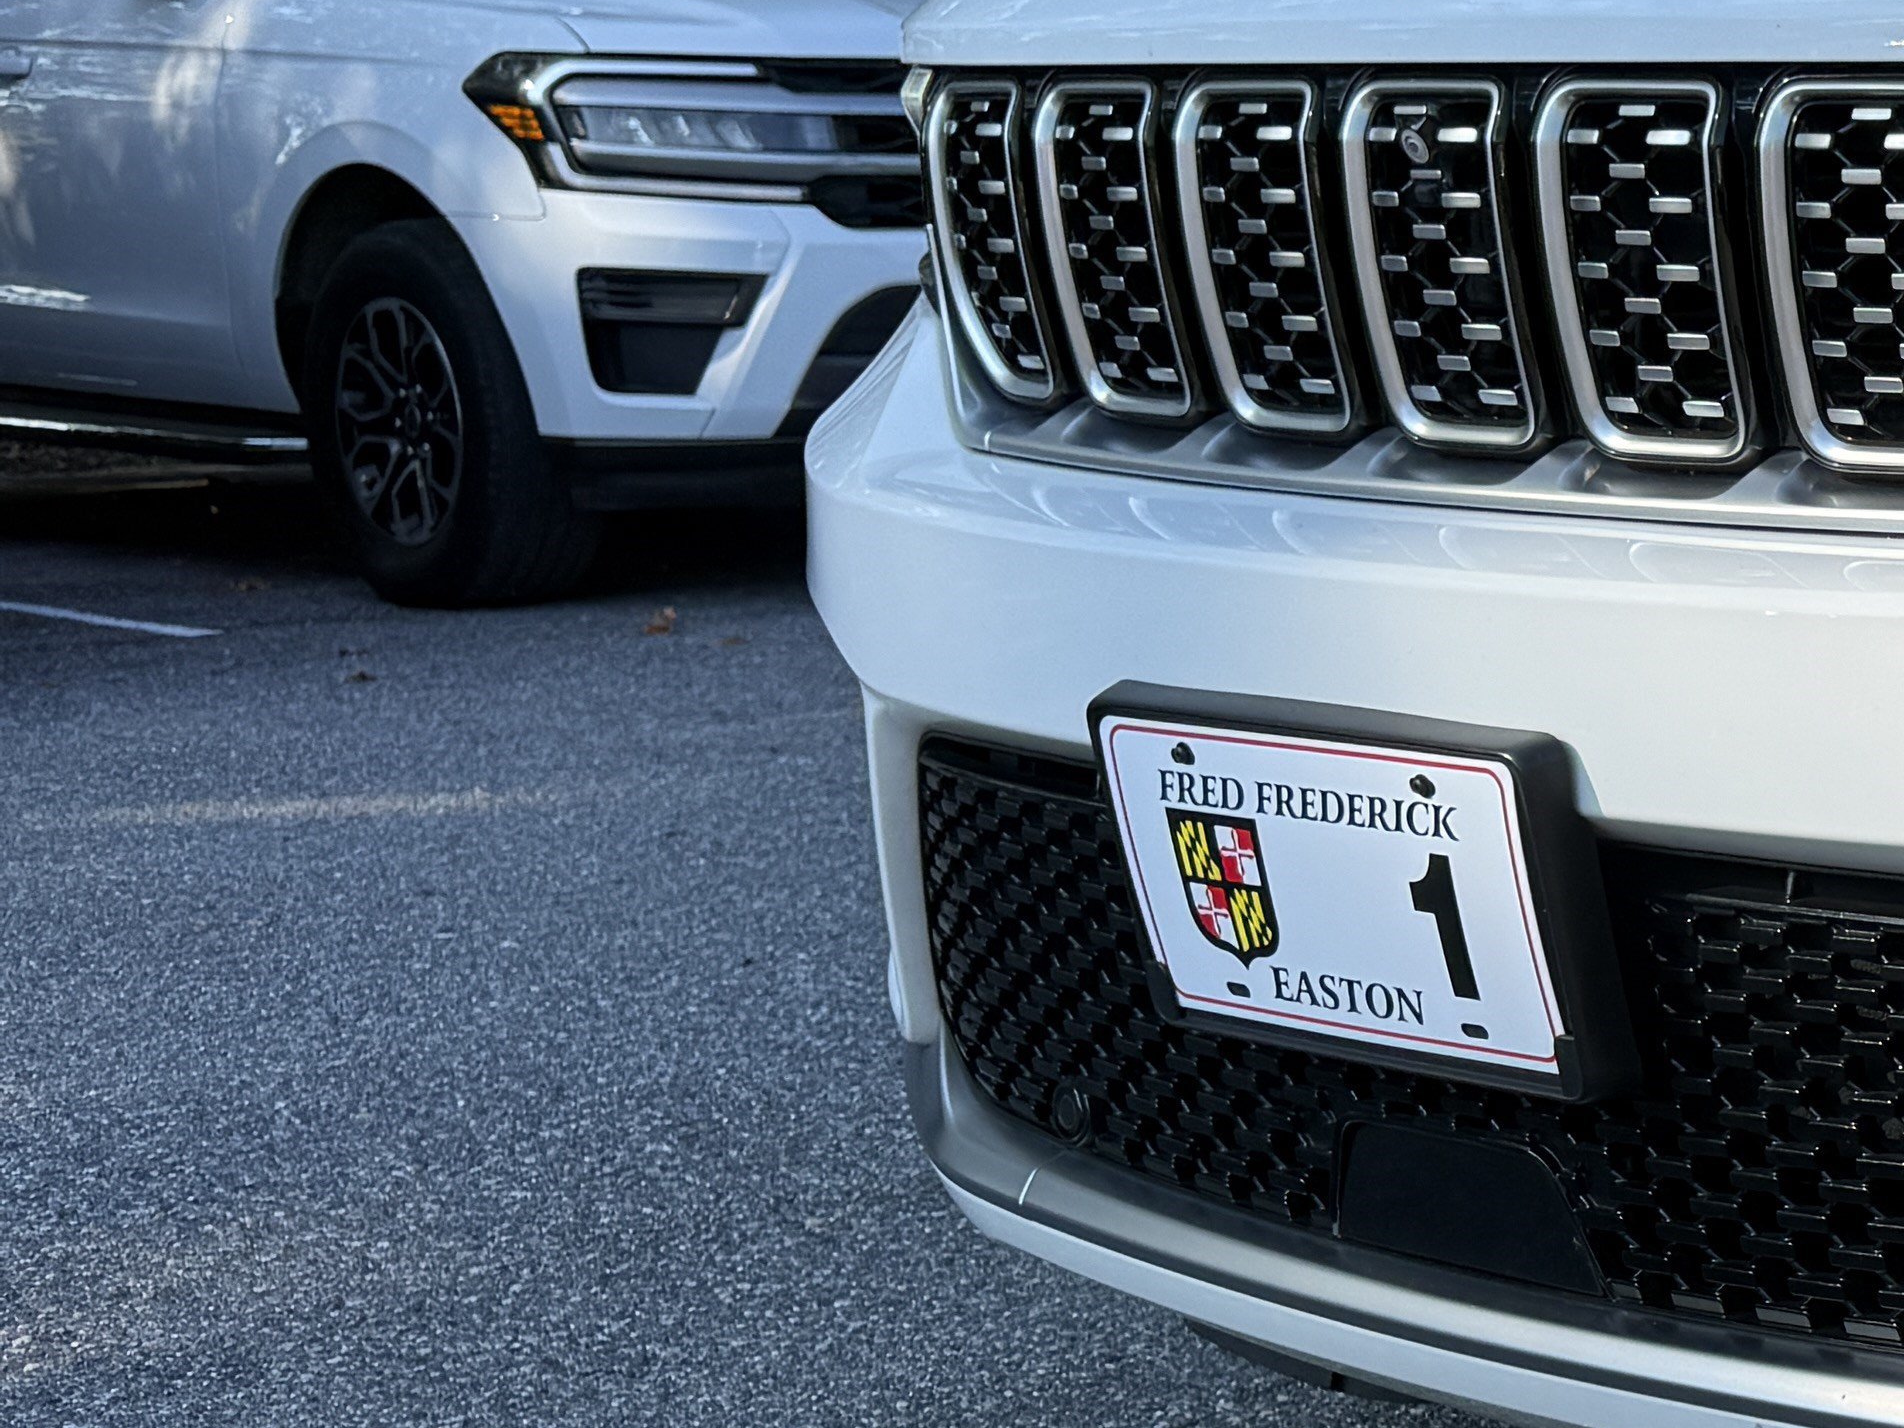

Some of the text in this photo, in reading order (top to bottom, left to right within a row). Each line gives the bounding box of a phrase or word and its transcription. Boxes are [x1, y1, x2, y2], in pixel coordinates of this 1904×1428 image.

[1157, 768, 1460, 842] FRED FREDERICK
[1409, 853, 1481, 1001] 1
[1269, 965, 1425, 1026] EASTON
